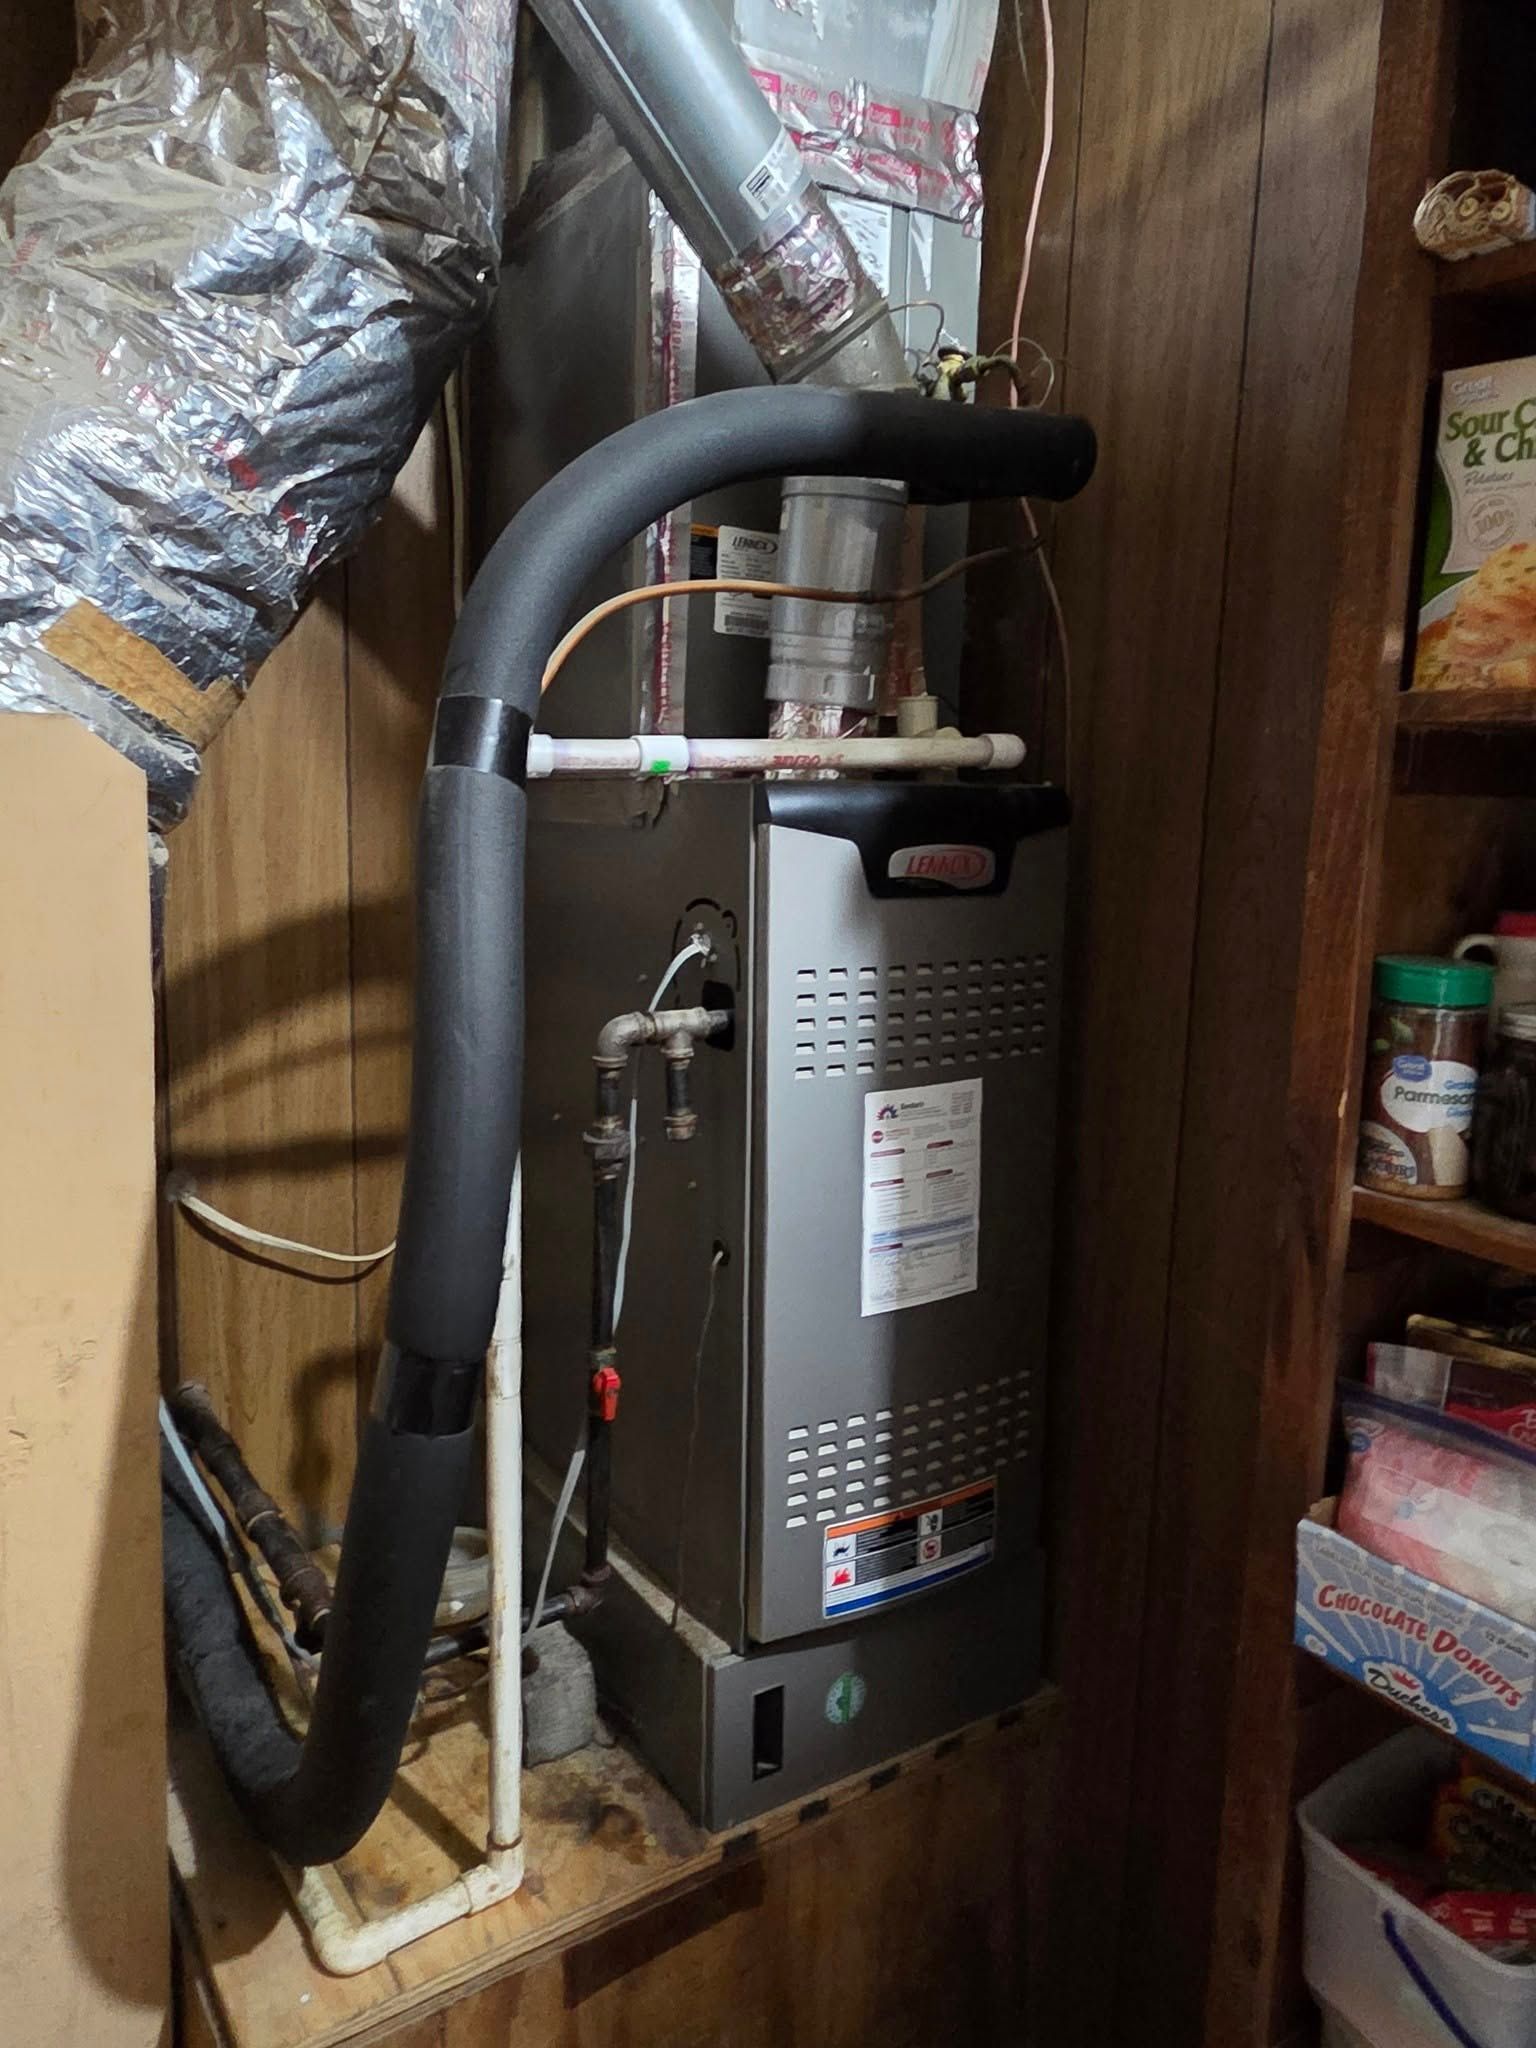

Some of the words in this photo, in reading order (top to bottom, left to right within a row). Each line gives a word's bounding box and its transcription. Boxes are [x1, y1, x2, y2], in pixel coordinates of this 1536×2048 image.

[1446, 410, 1511, 441] Sour
[1514, 397, 1536, 430] C
[1463, 437, 1486, 468] &
[1495, 428, 1536, 463] Ch
[731, 535, 770, 552] LENNOX
[905, 853, 976, 876] LENNOX
[1318, 1584, 1428, 1642] CHOCOLATE
[1432, 1629, 1523, 1707] DONUTS
[1366, 1667, 1453, 1731] Duchess
